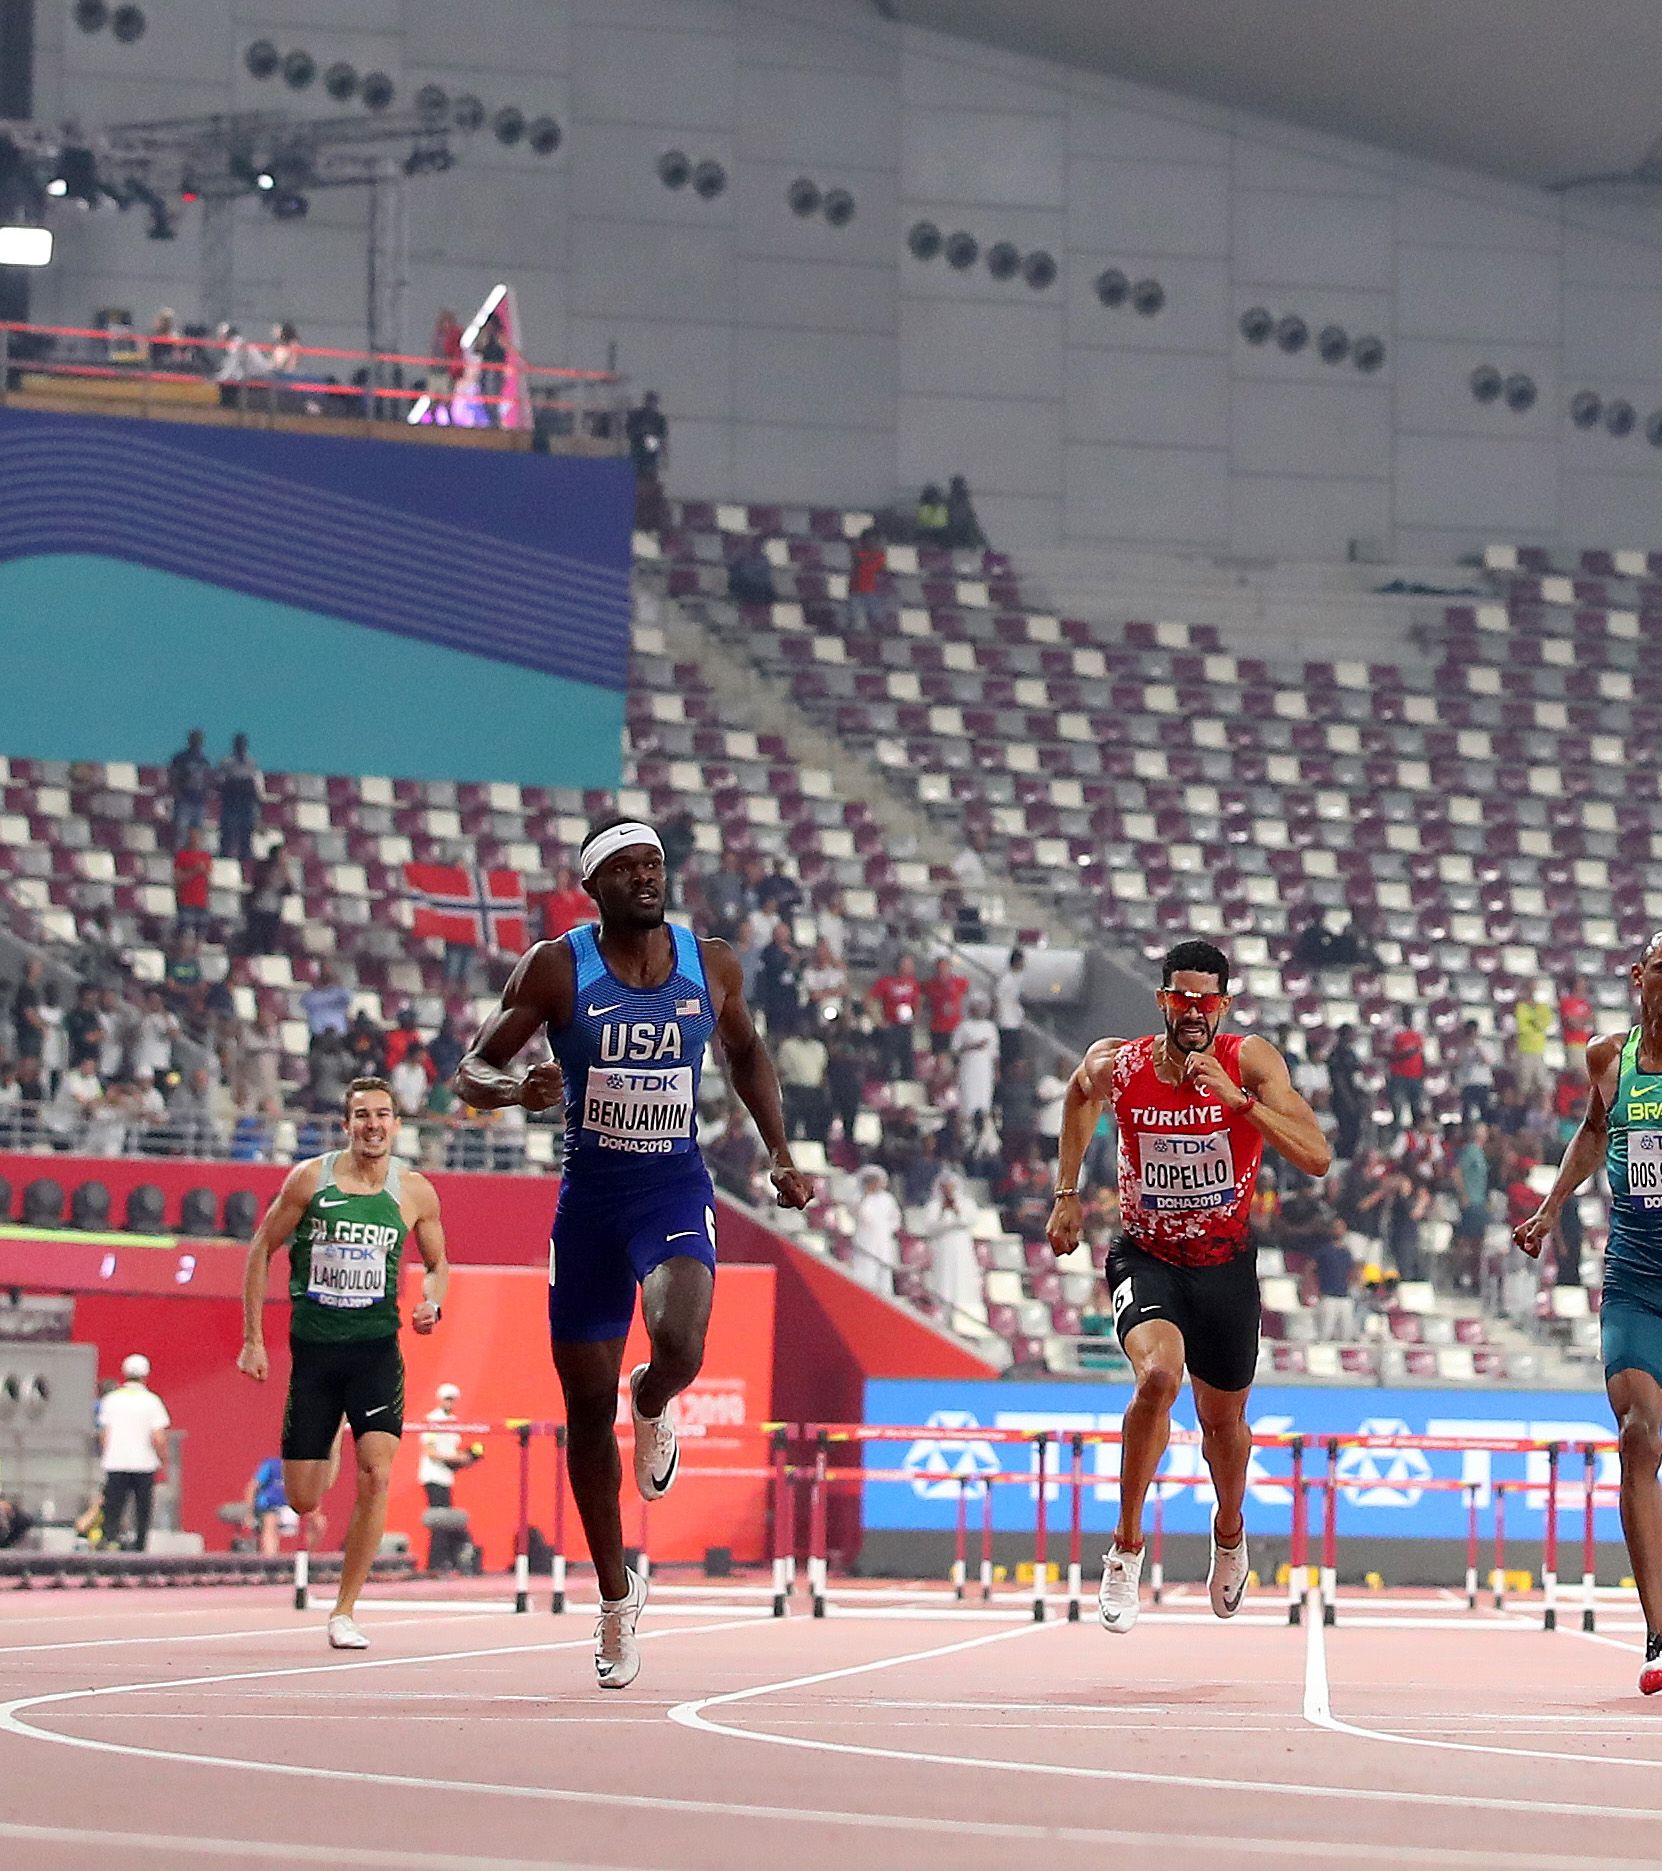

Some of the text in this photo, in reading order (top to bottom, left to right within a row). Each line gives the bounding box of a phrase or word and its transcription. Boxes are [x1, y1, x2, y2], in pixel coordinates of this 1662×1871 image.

[601, 1022, 682, 1062] USA
[625, 1074, 679, 1092] TDK
[588, 1098, 687, 1131] BENJAMIN
[1130, 1104, 1223, 1127] TÜRKİYE
[598, 1134, 674, 1153] DOHA2019
[1167, 1137, 1217, 1155] TDK
[1145, 1159, 1227, 1190] COPELLO
[1631, 1161, 1657, 1188] DOS
[1157, 1193, 1222, 1209] DOHA2019
[337, 1246, 377, 1260] TDK
[314, 1264, 382, 1290] LAHOULOU
